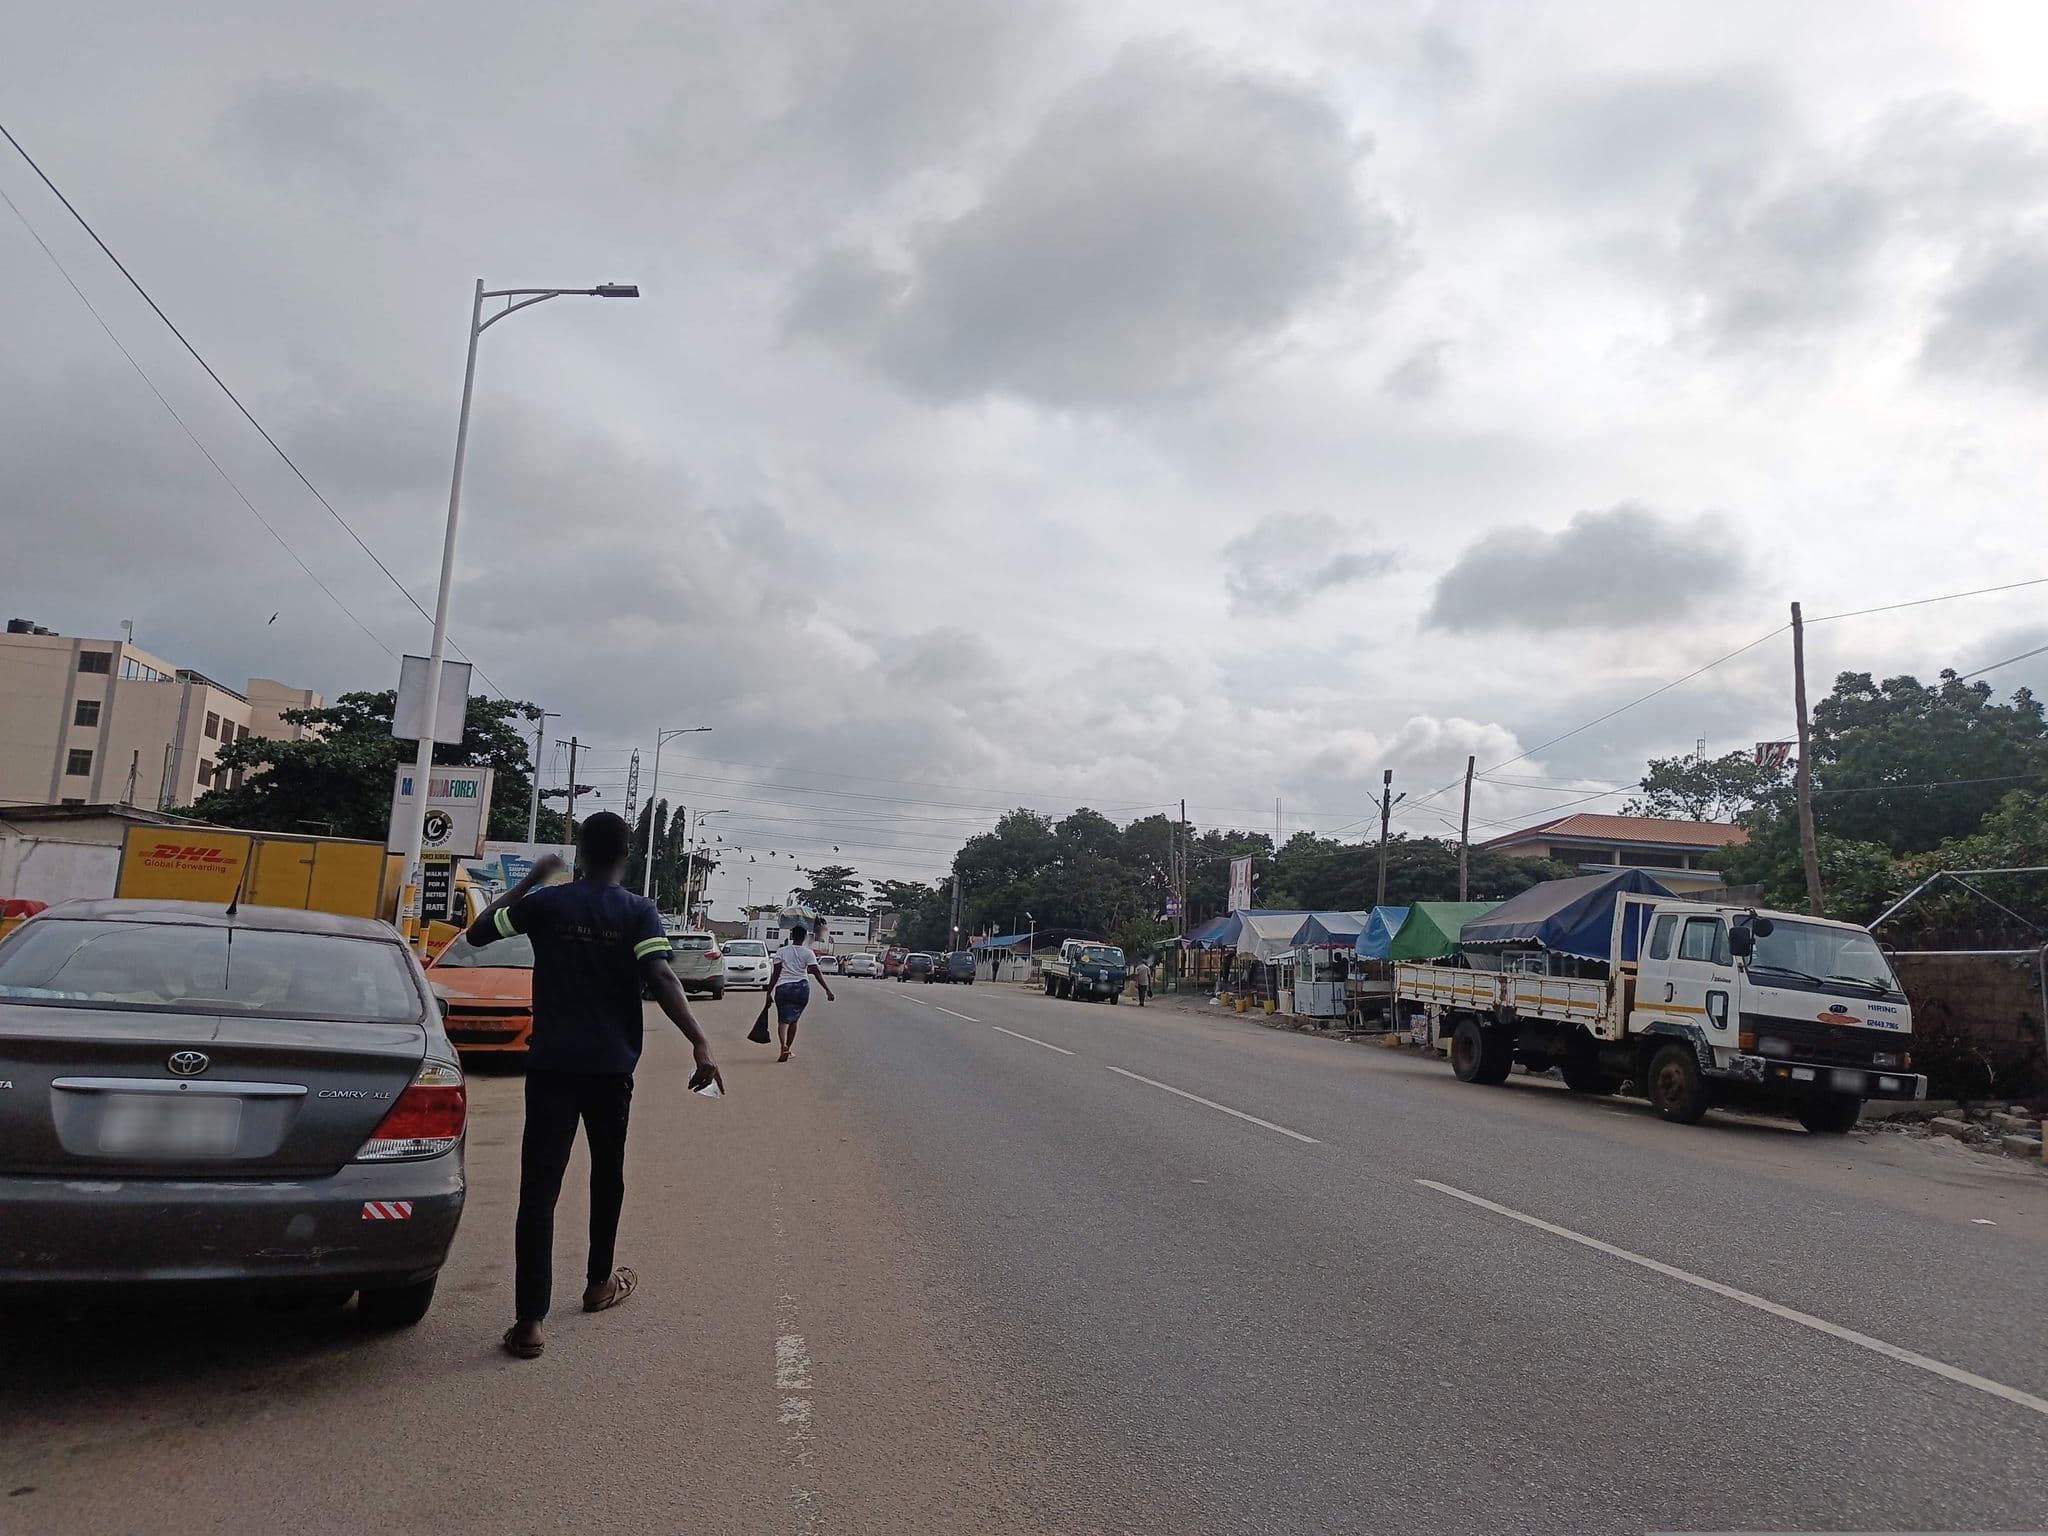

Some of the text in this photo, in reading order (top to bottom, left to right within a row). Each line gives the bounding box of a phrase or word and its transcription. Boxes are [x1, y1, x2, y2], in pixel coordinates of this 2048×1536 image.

[150, 844, 226, 862] DHL
[144, 859, 226, 874] Global Forwarding
[425, 903, 446, 911] RATE
[1867, 1004, 1897, 1013] HIRING
[318, 1089, 391, 1099] CAMRY XLE
